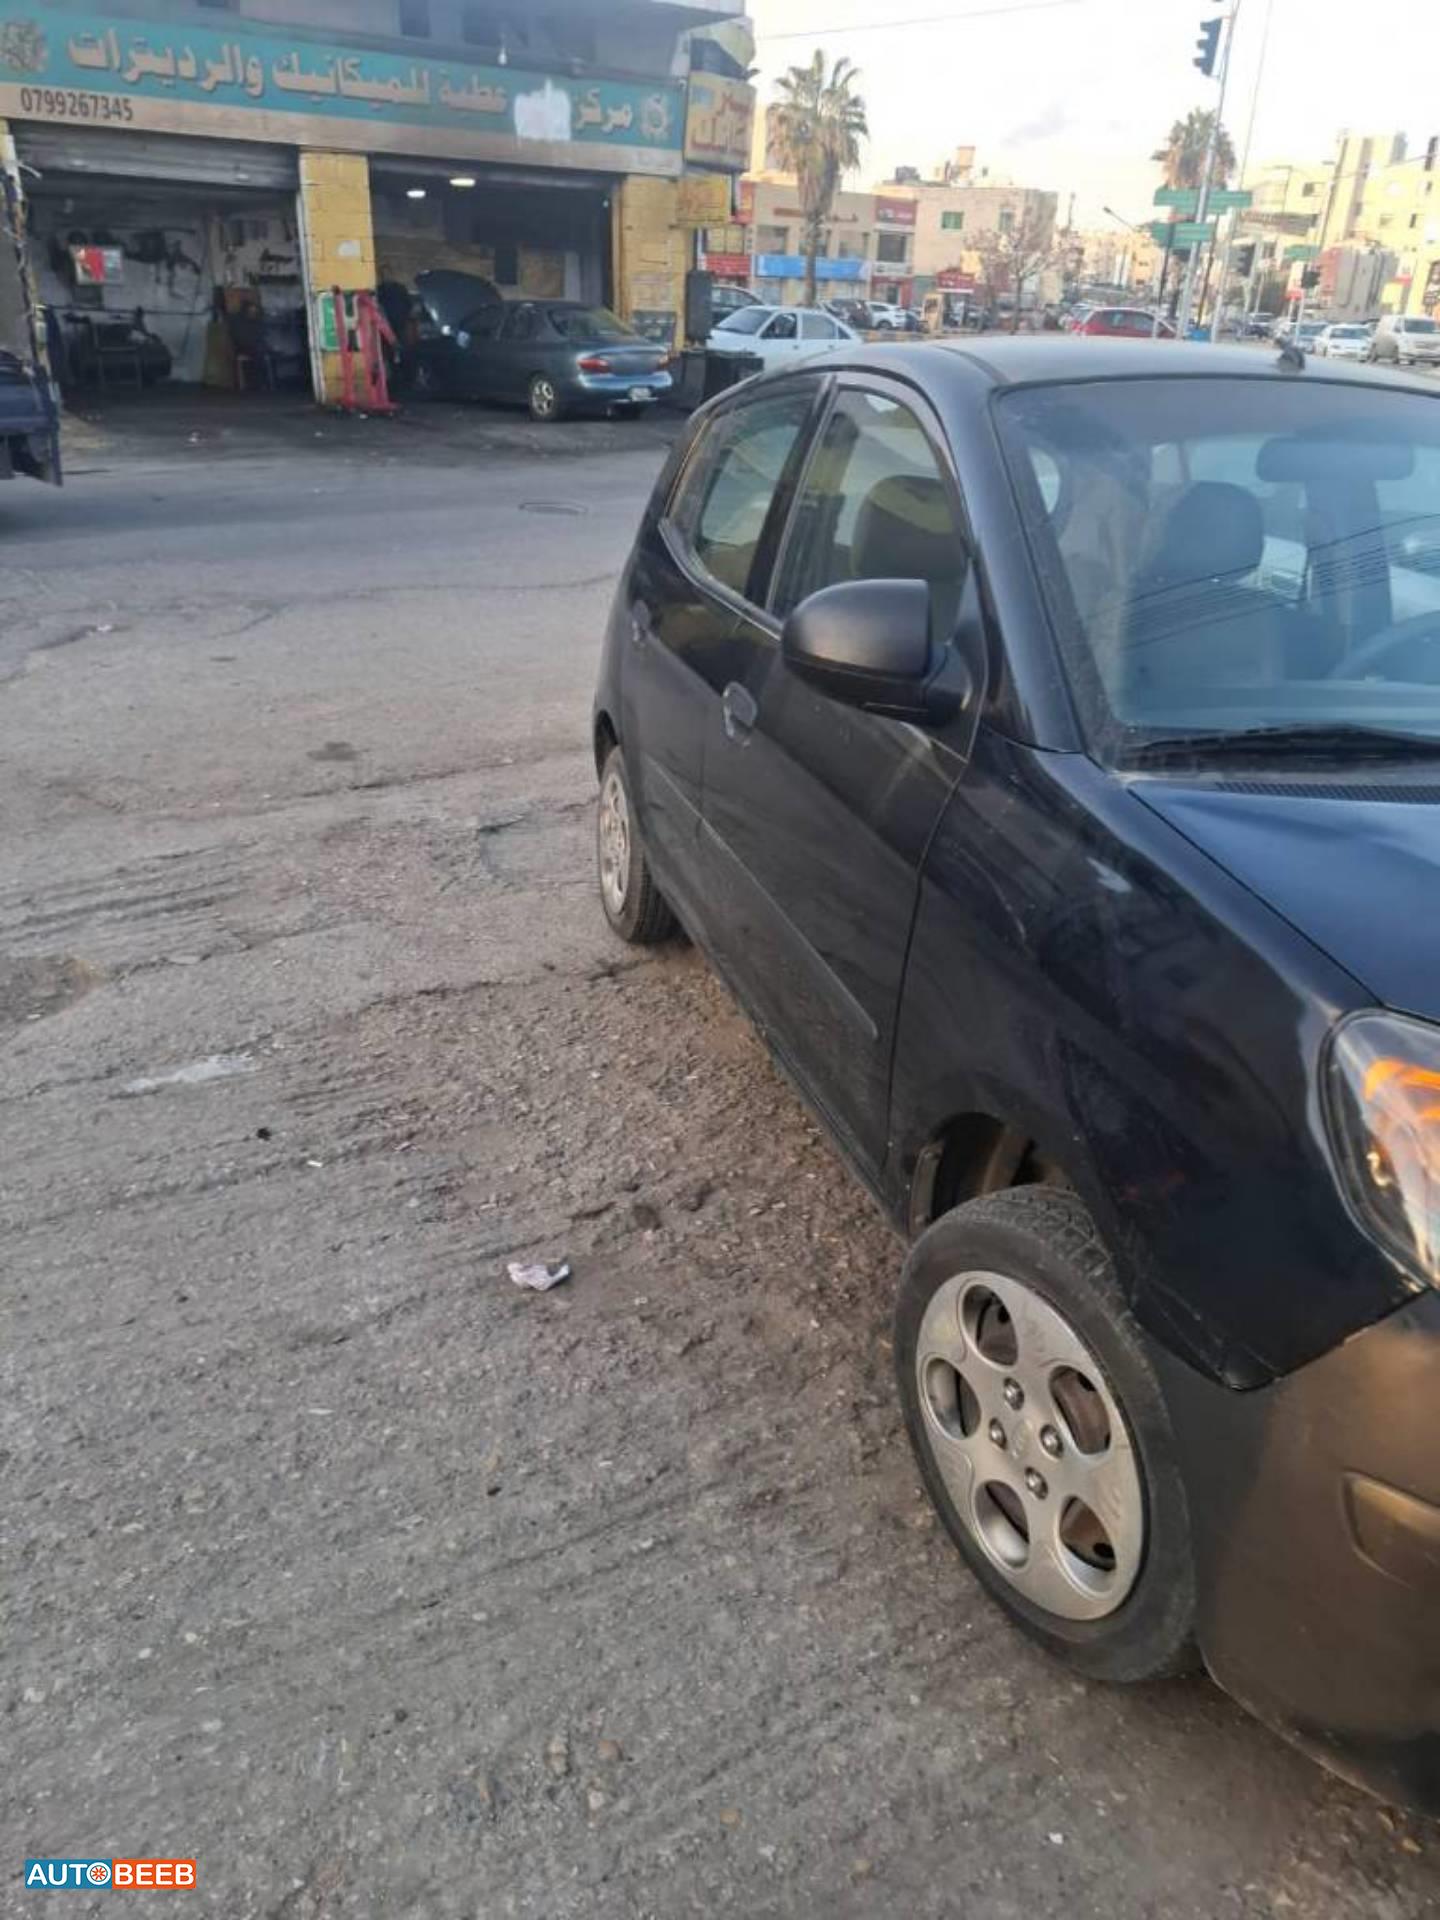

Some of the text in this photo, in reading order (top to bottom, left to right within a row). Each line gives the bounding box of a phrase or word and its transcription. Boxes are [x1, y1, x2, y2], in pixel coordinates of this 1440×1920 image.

[20, 87, 133, 121] 0799267345
[271, 50, 430, 112] للميكانيك
[574, 88, 633, 134] مركز
